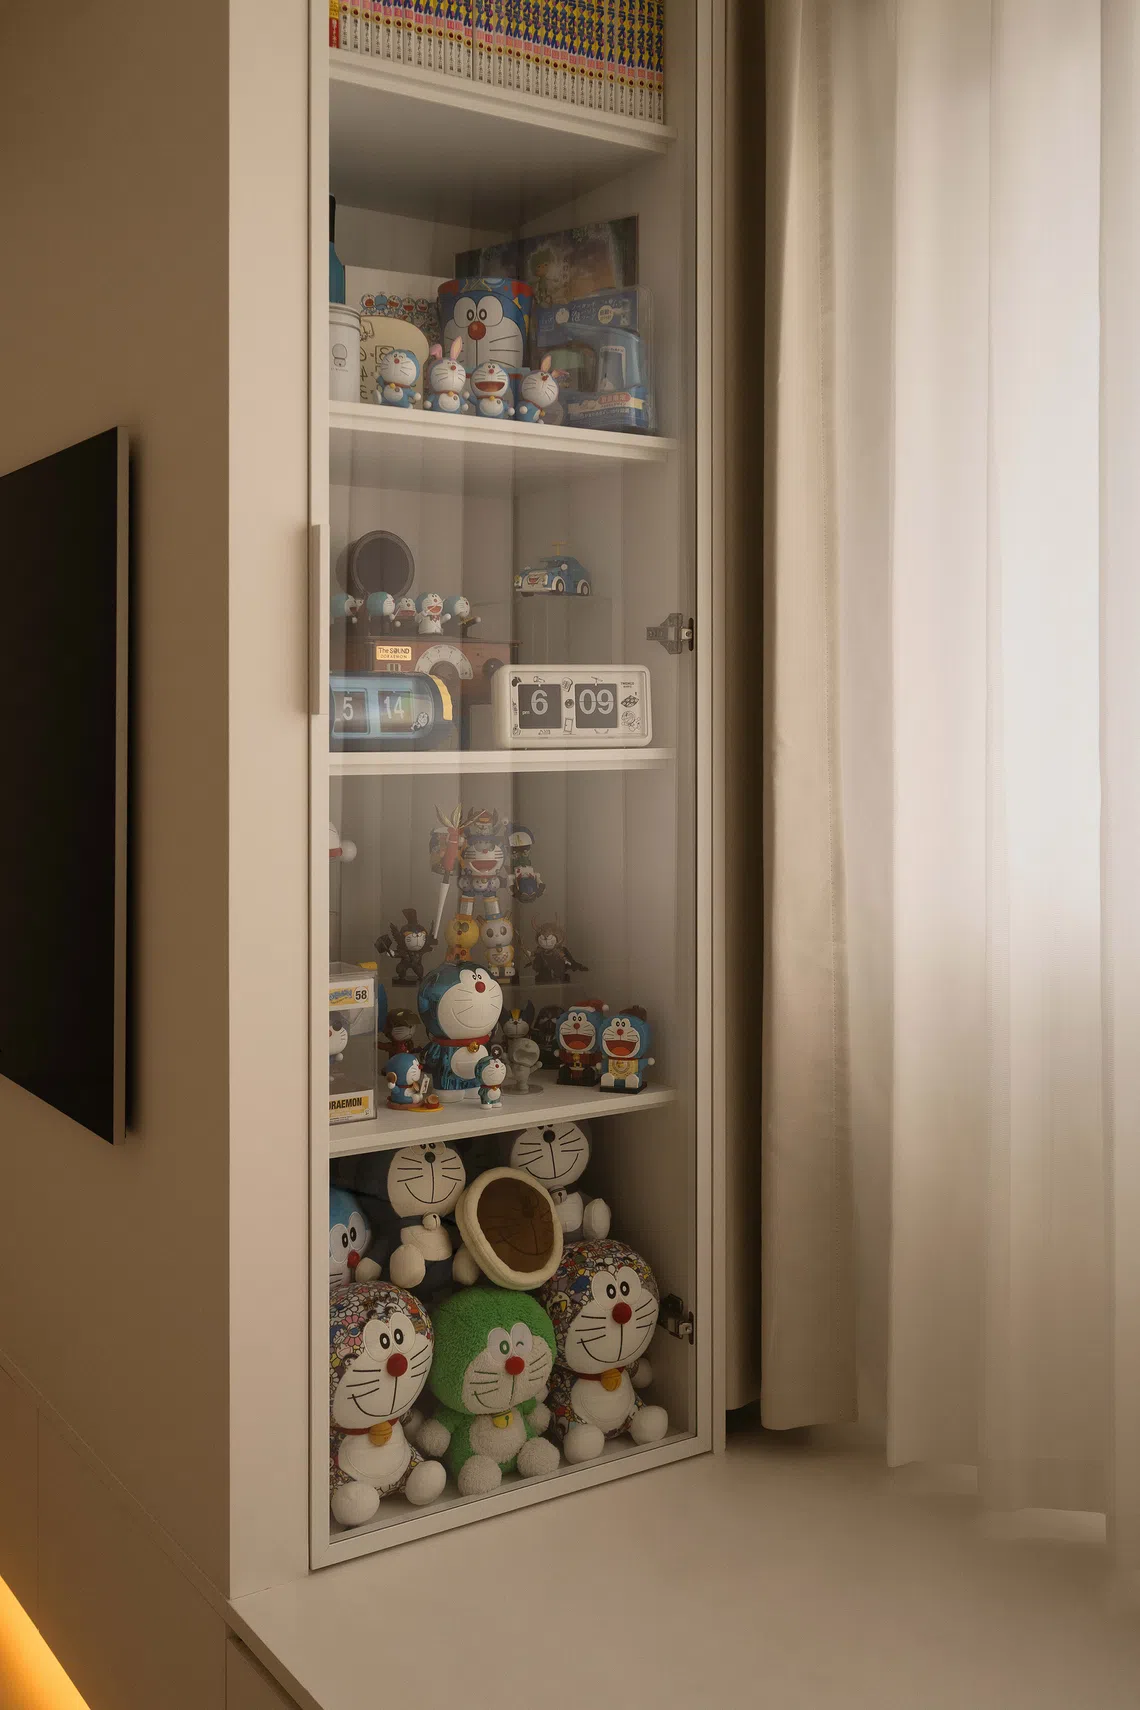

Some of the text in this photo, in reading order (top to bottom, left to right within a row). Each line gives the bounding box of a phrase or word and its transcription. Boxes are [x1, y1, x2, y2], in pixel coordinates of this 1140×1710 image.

[646, 2, 655, 70] ドラえもん
[655, 4, 664, 73] ドラえもん
[389, 647, 410, 655] SOUND
[342, 695, 405, 721] 5 14
[530, 689, 549, 716] 6
[578, 688, 614, 715] 09
[355, 990, 367, 1000] 58
